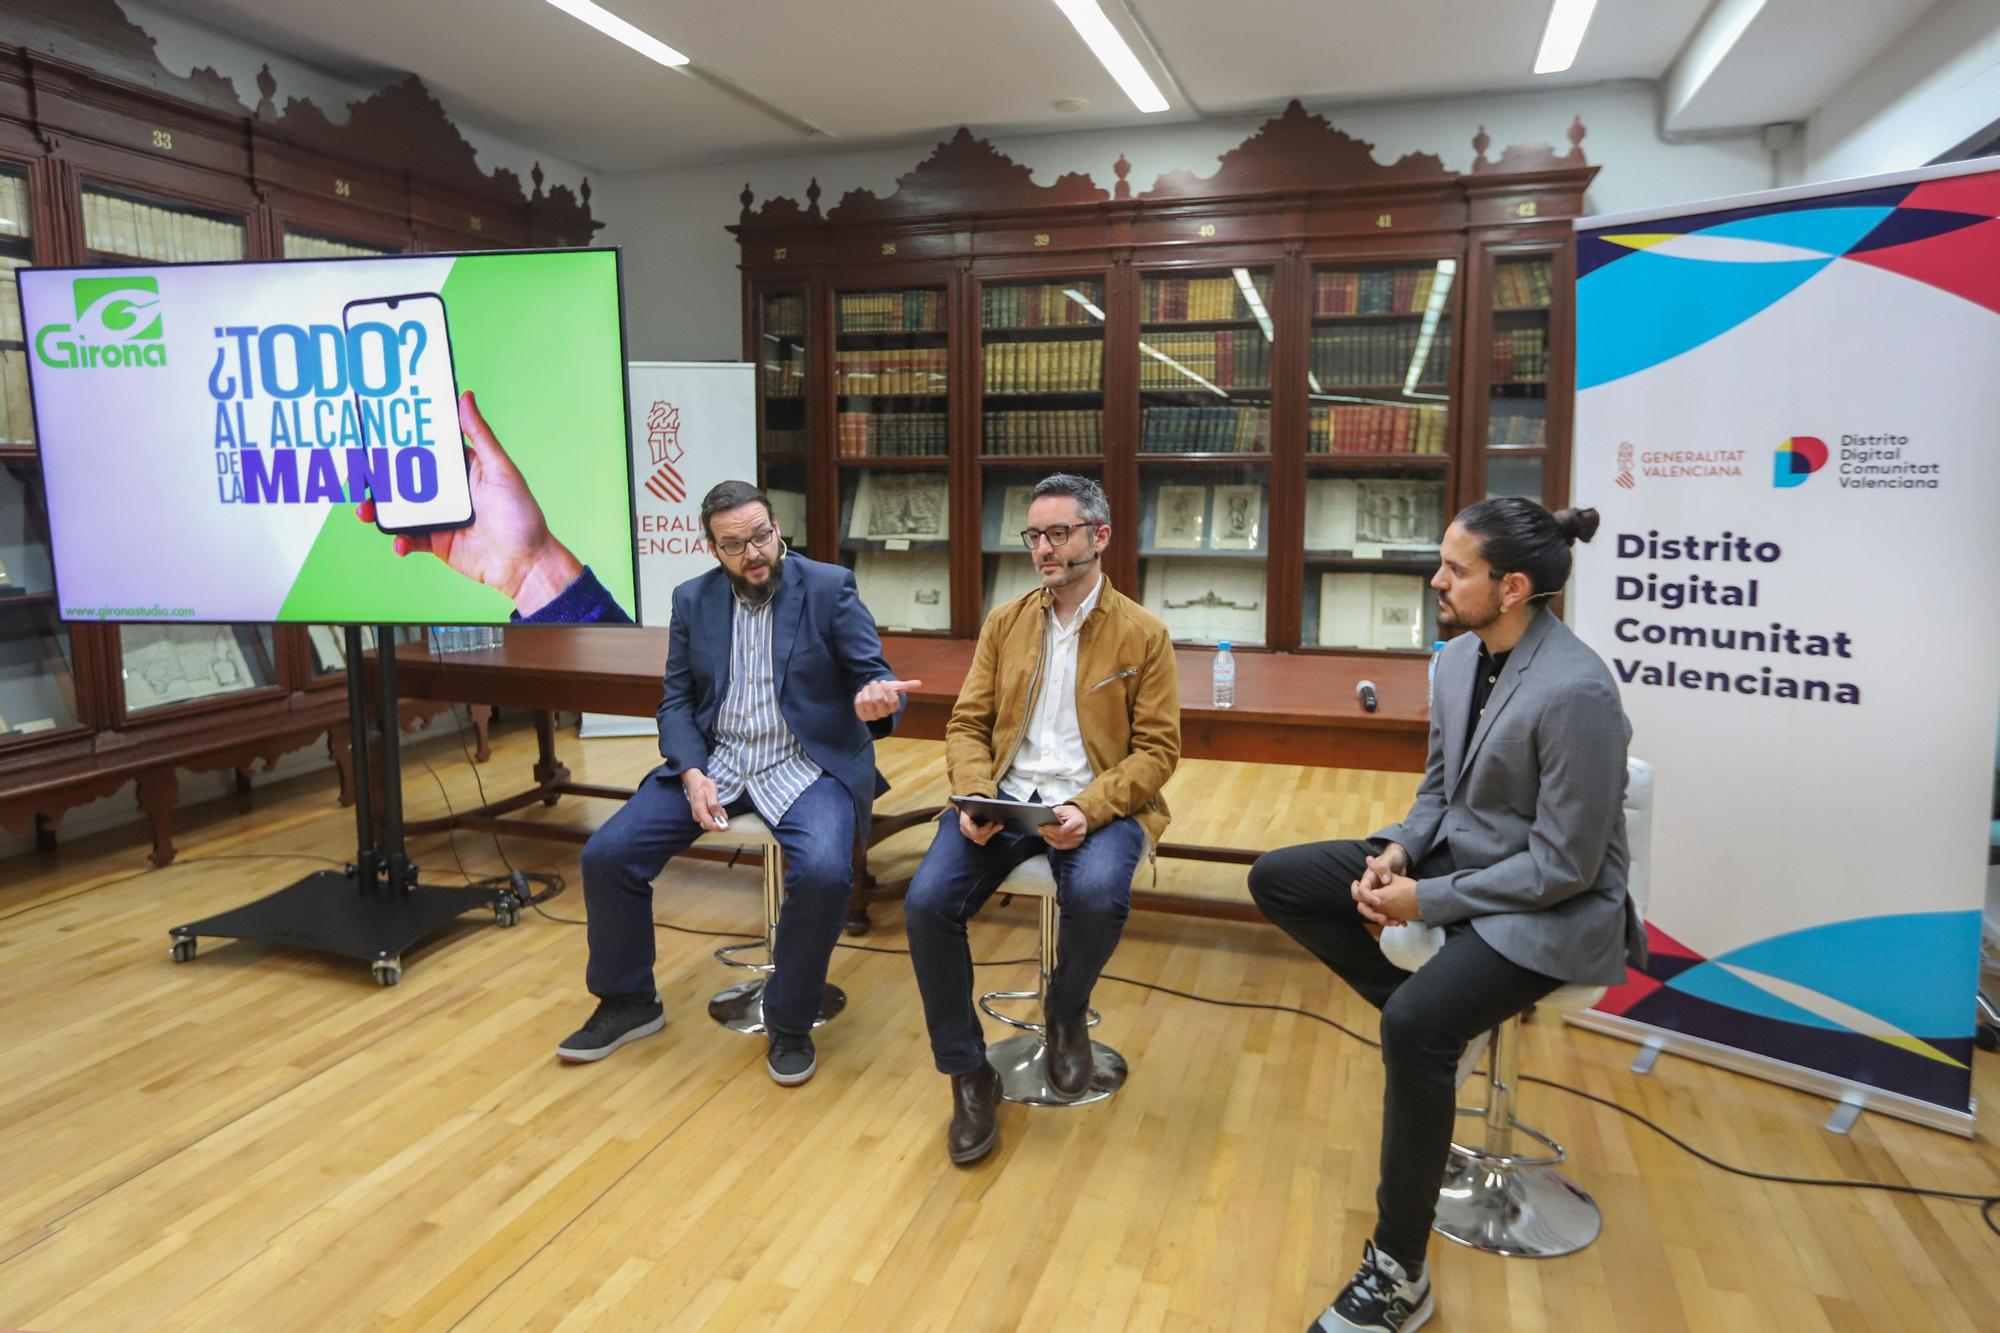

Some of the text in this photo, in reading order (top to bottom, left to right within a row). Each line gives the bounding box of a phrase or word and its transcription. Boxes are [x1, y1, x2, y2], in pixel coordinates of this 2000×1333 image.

[153, 130, 172, 149] 33
[336, 180, 350, 197] 34
[1376, 214, 1391, 228] 41
[1198, 224, 1215, 237] 40
[1034, 234, 1050, 246] 39
[881, 243, 896, 255] 38
[35, 324, 167, 368] Girona
[208, 320, 428, 400] ¿TODO?
[214, 397, 435, 449] AL ALCANCE
[1841, 433, 1909, 446] Distrito
[216, 452, 241, 475] DE
[1641, 450, 1745, 464] GENERALITAT
[1841, 447, 1901, 463] Digital
[240, 446, 439, 504] MANO
[1642, 465, 1742, 477] VALENCIANA
[1840, 461, 1939, 475] Comunitat
[218, 475, 246, 504] LA
[1839, 476, 1939, 489] Valenciana
[1617, 530, 1781, 563] Distrito
[1616, 573, 1758, 610] Digital
[64, 603, 196, 620] www.gironastudio.com
[1614, 618, 1853, 659] Comunitat
[1613, 658, 1861, 705] Valenciana
